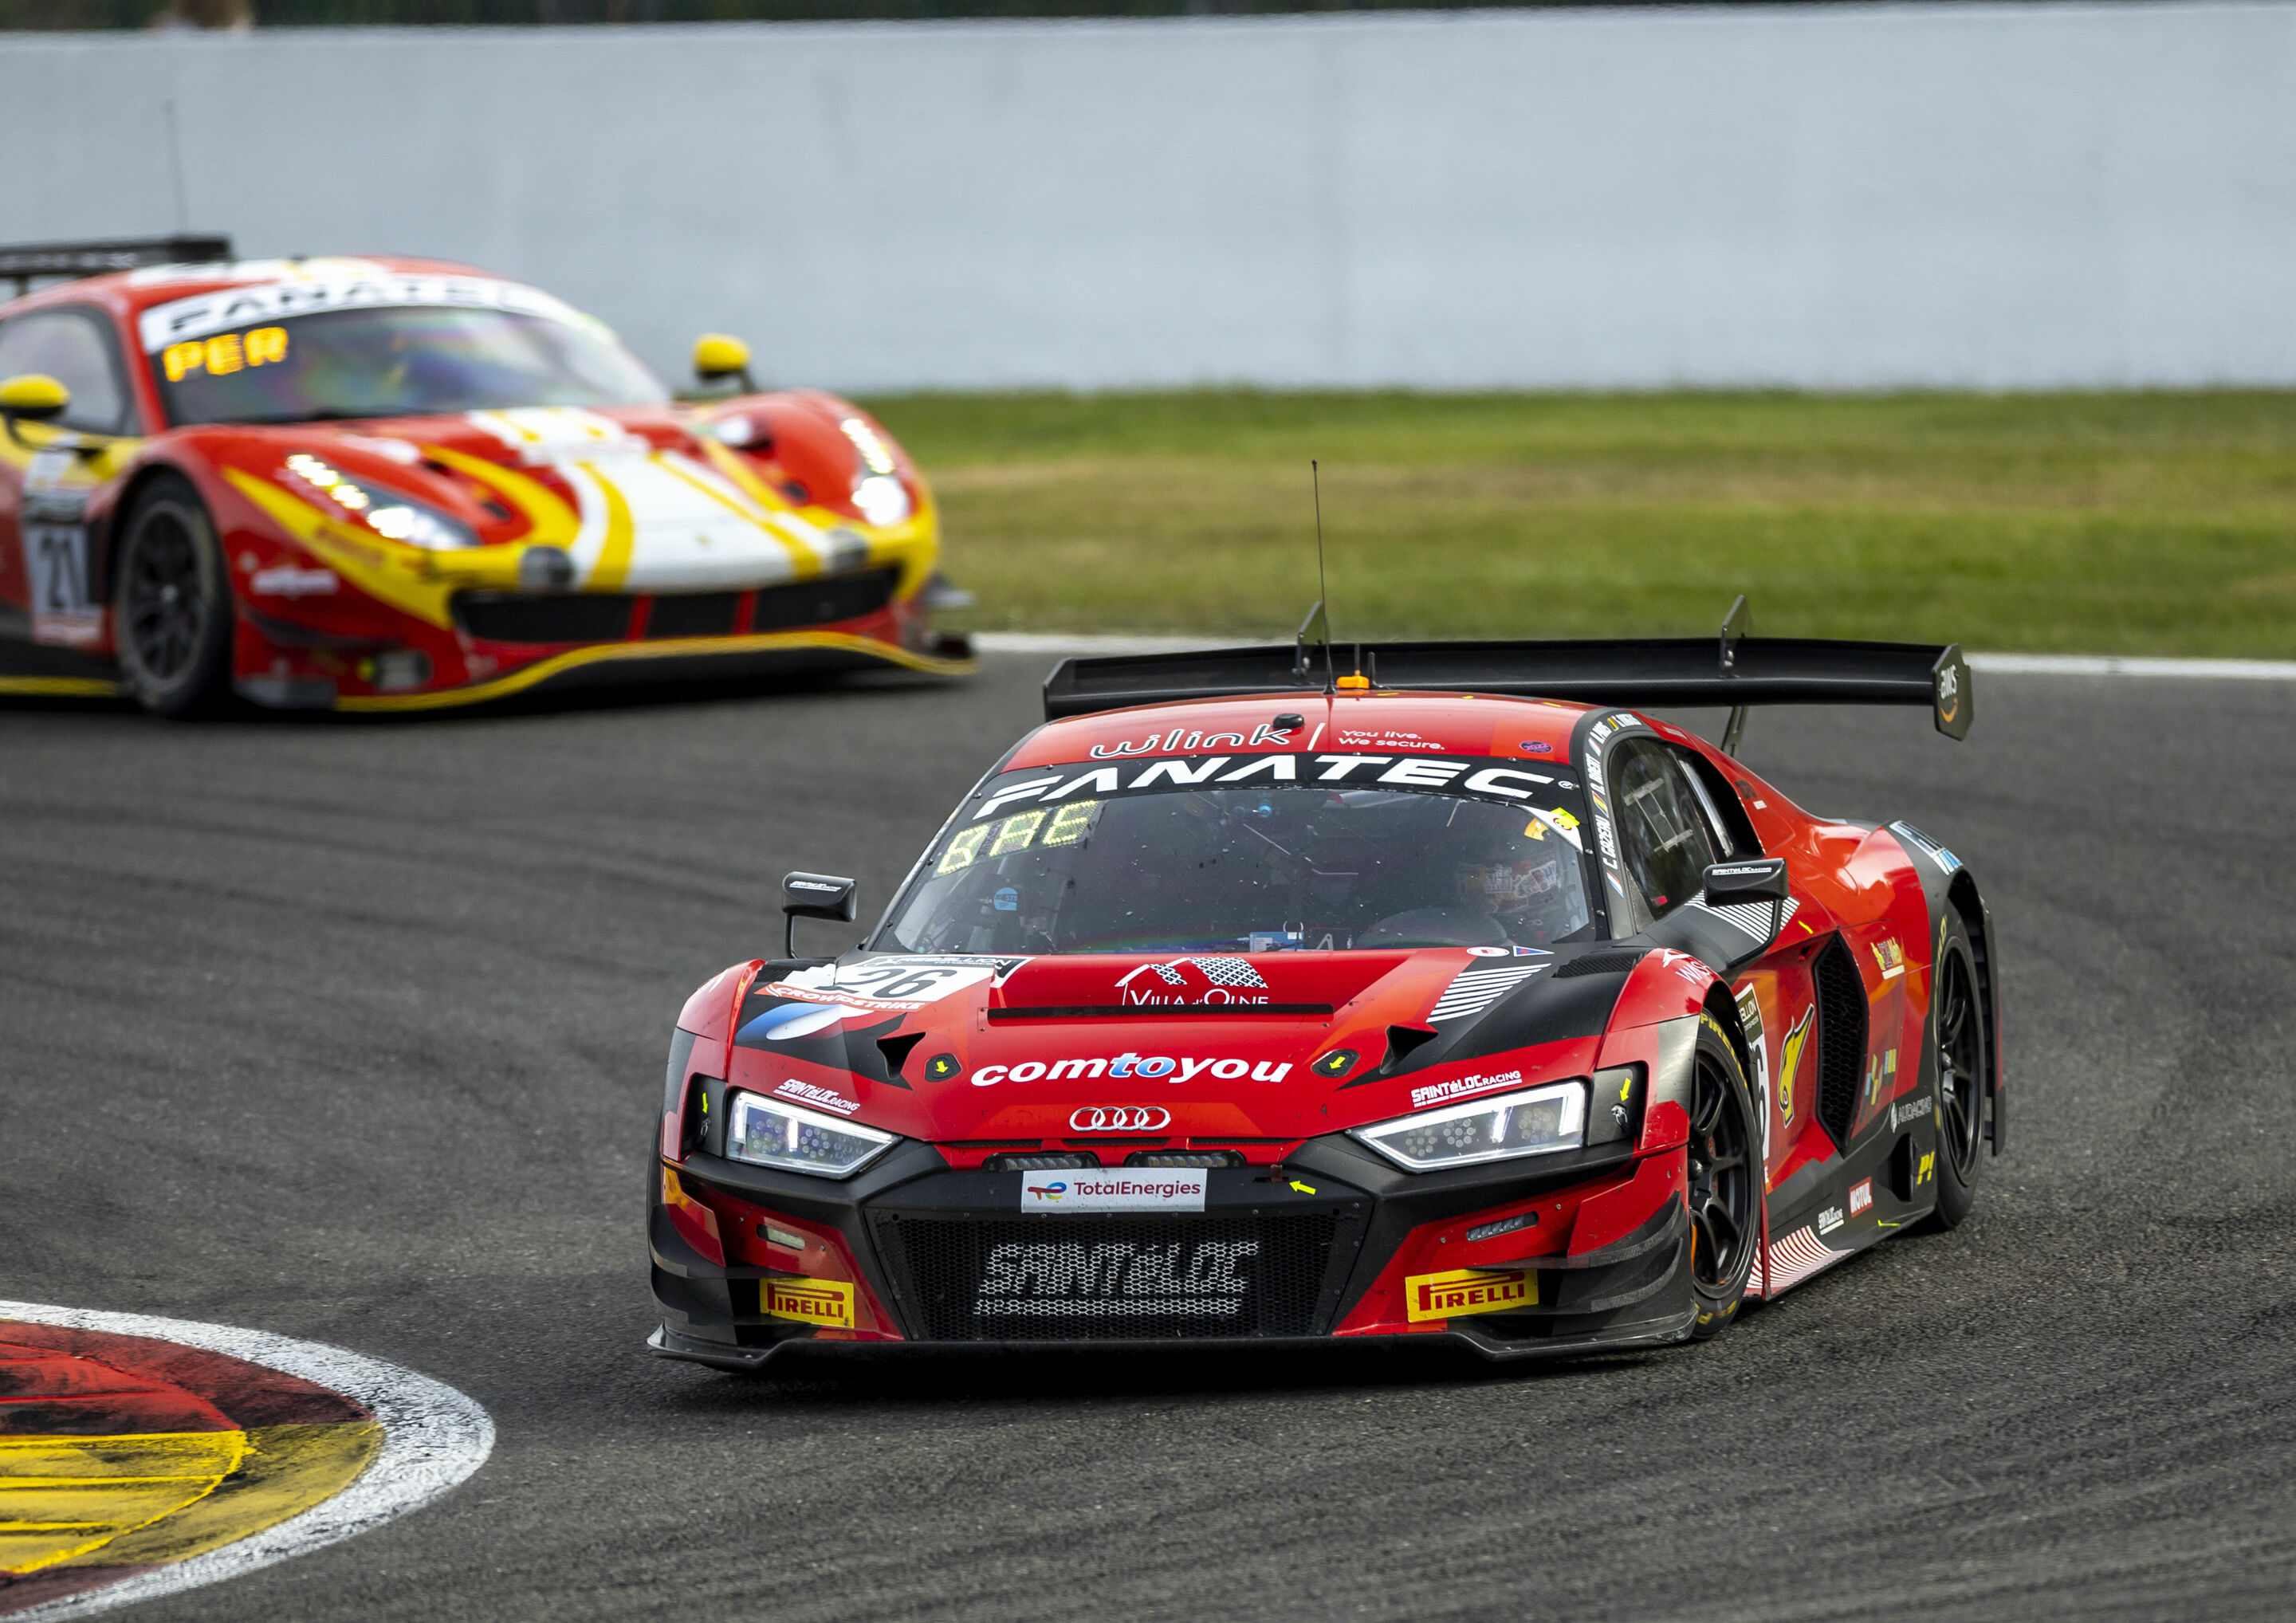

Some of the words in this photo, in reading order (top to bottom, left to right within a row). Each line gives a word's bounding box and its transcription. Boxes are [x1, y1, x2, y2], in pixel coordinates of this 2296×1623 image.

[169, 281, 517, 330] FANATE
[163, 326, 289, 383] PER
[1940, 664, 1957, 699] aws
[1090, 723, 1292, 758] wilink
[1341, 729, 1378, 738] You
[1385, 730, 1422, 740] live.
[1375, 738, 1445, 750] secure.
[973, 753, 1554, 820] FANATEC
[776, 985, 926, 1010] CROWDSTRIKE
[815, 968, 958, 998] 26
[1739, 998, 1758, 1022] ELLION
[971, 1052, 1294, 1087] comtoyou
[1074, 1180, 1201, 1198] TotalEnergies
[767, 1282, 845, 1318] PIRELLI
[1417, 1271, 1525, 1312] PIRELLI
